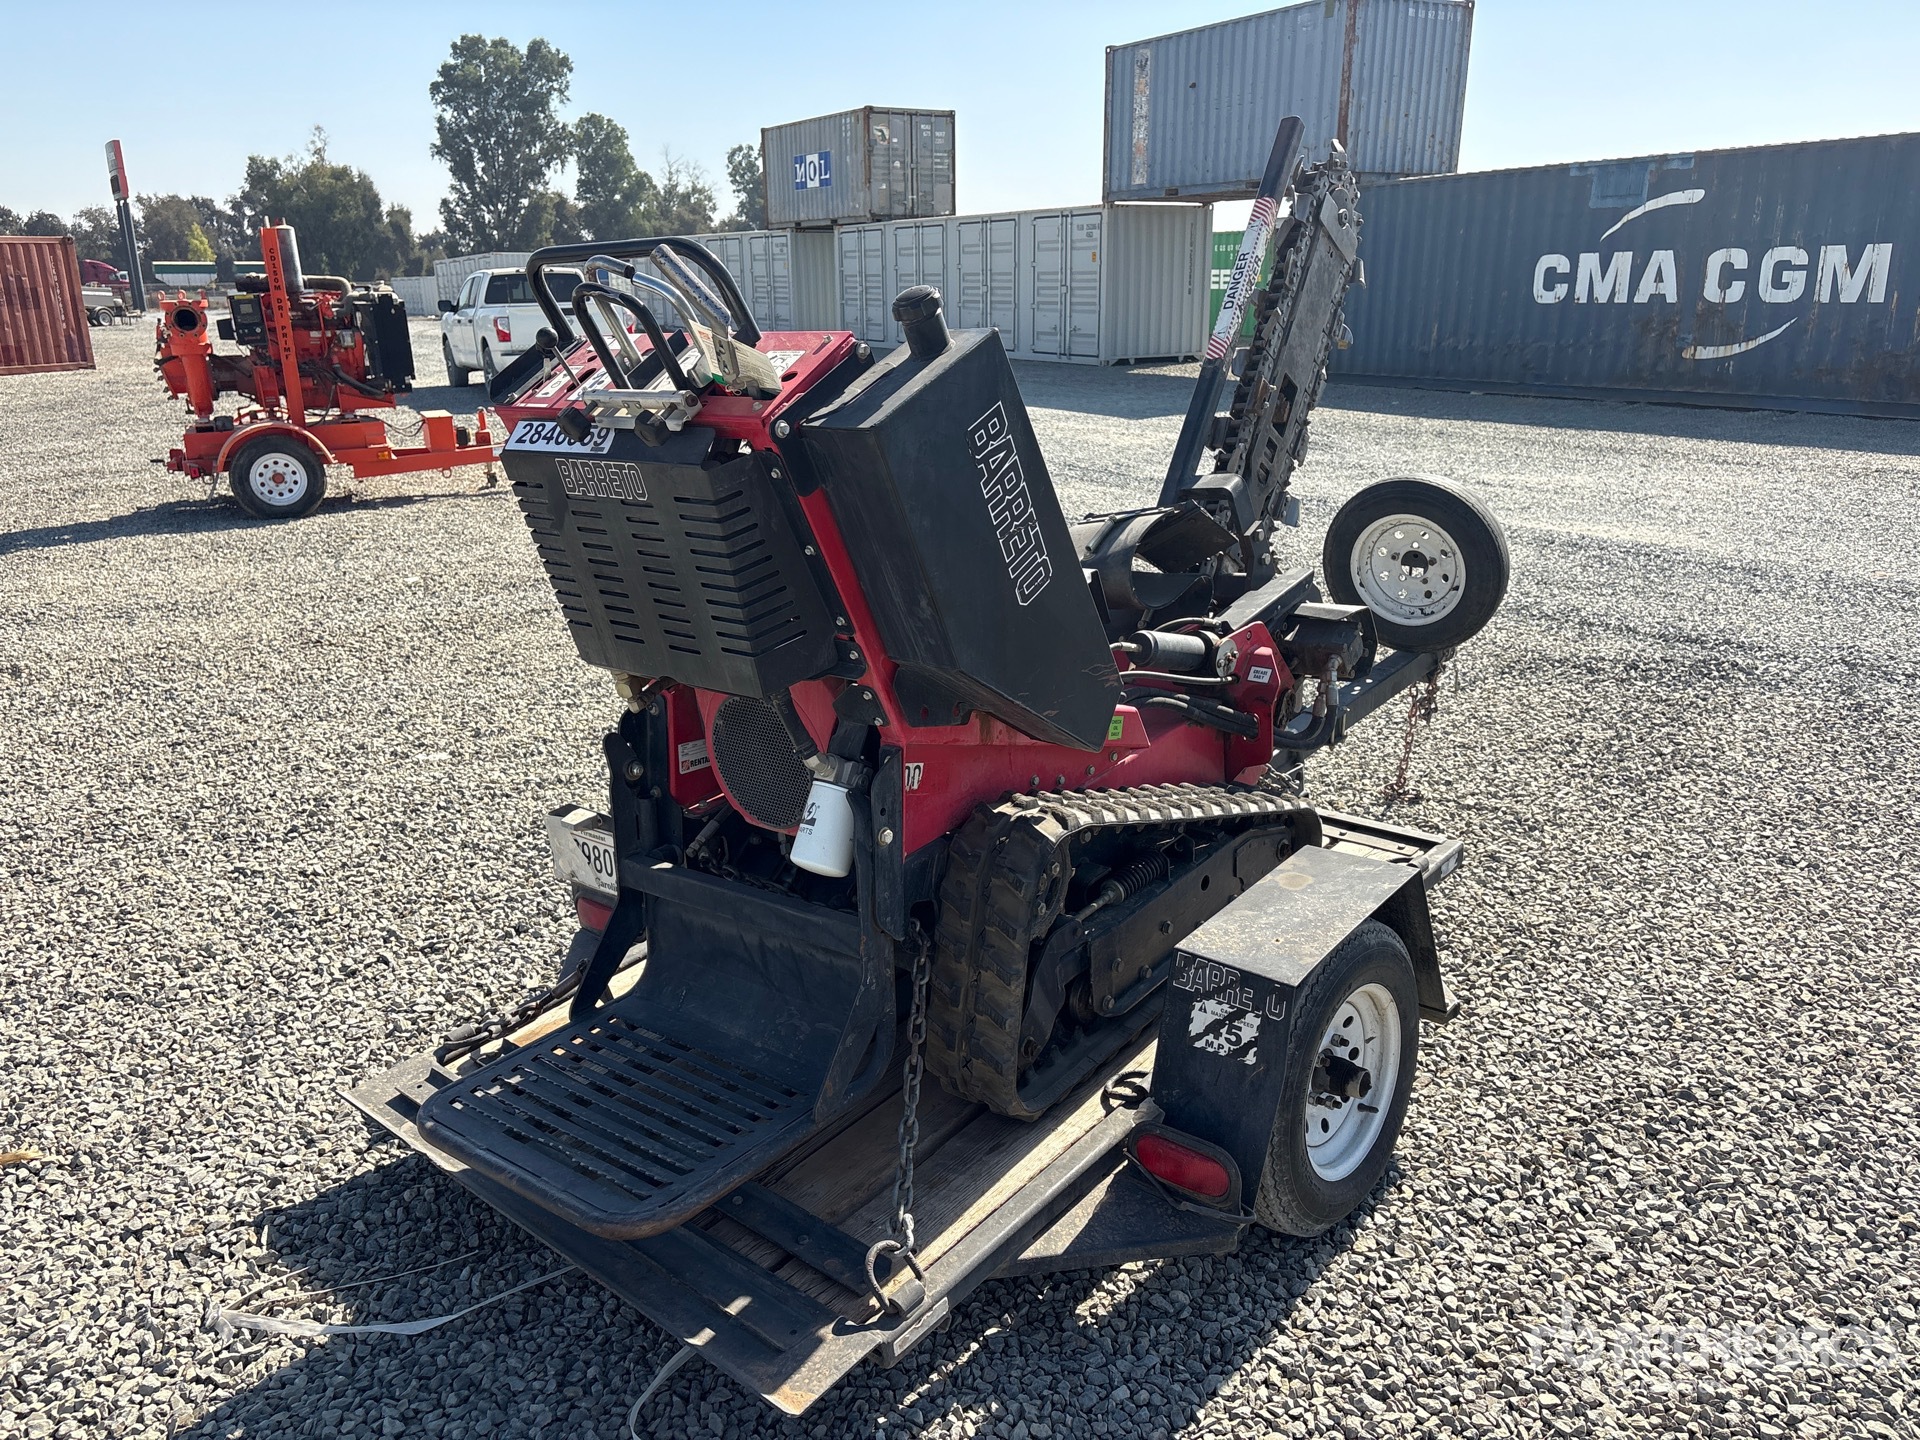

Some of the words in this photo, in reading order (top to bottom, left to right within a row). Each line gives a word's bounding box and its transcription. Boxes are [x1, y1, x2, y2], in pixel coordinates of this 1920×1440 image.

[794, 160, 830, 183] NOL
[1223, 252, 1250, 310] DANGER
[1533, 250, 1678, 304] CMA
[1703, 243, 1893, 304] CGM
[555, 458, 648, 500] BARRETO
[966, 401, 1052, 605] BARRETO
[595, 877, 618, 892] Caroli
[1173, 952, 1286, 1021] BARREO
